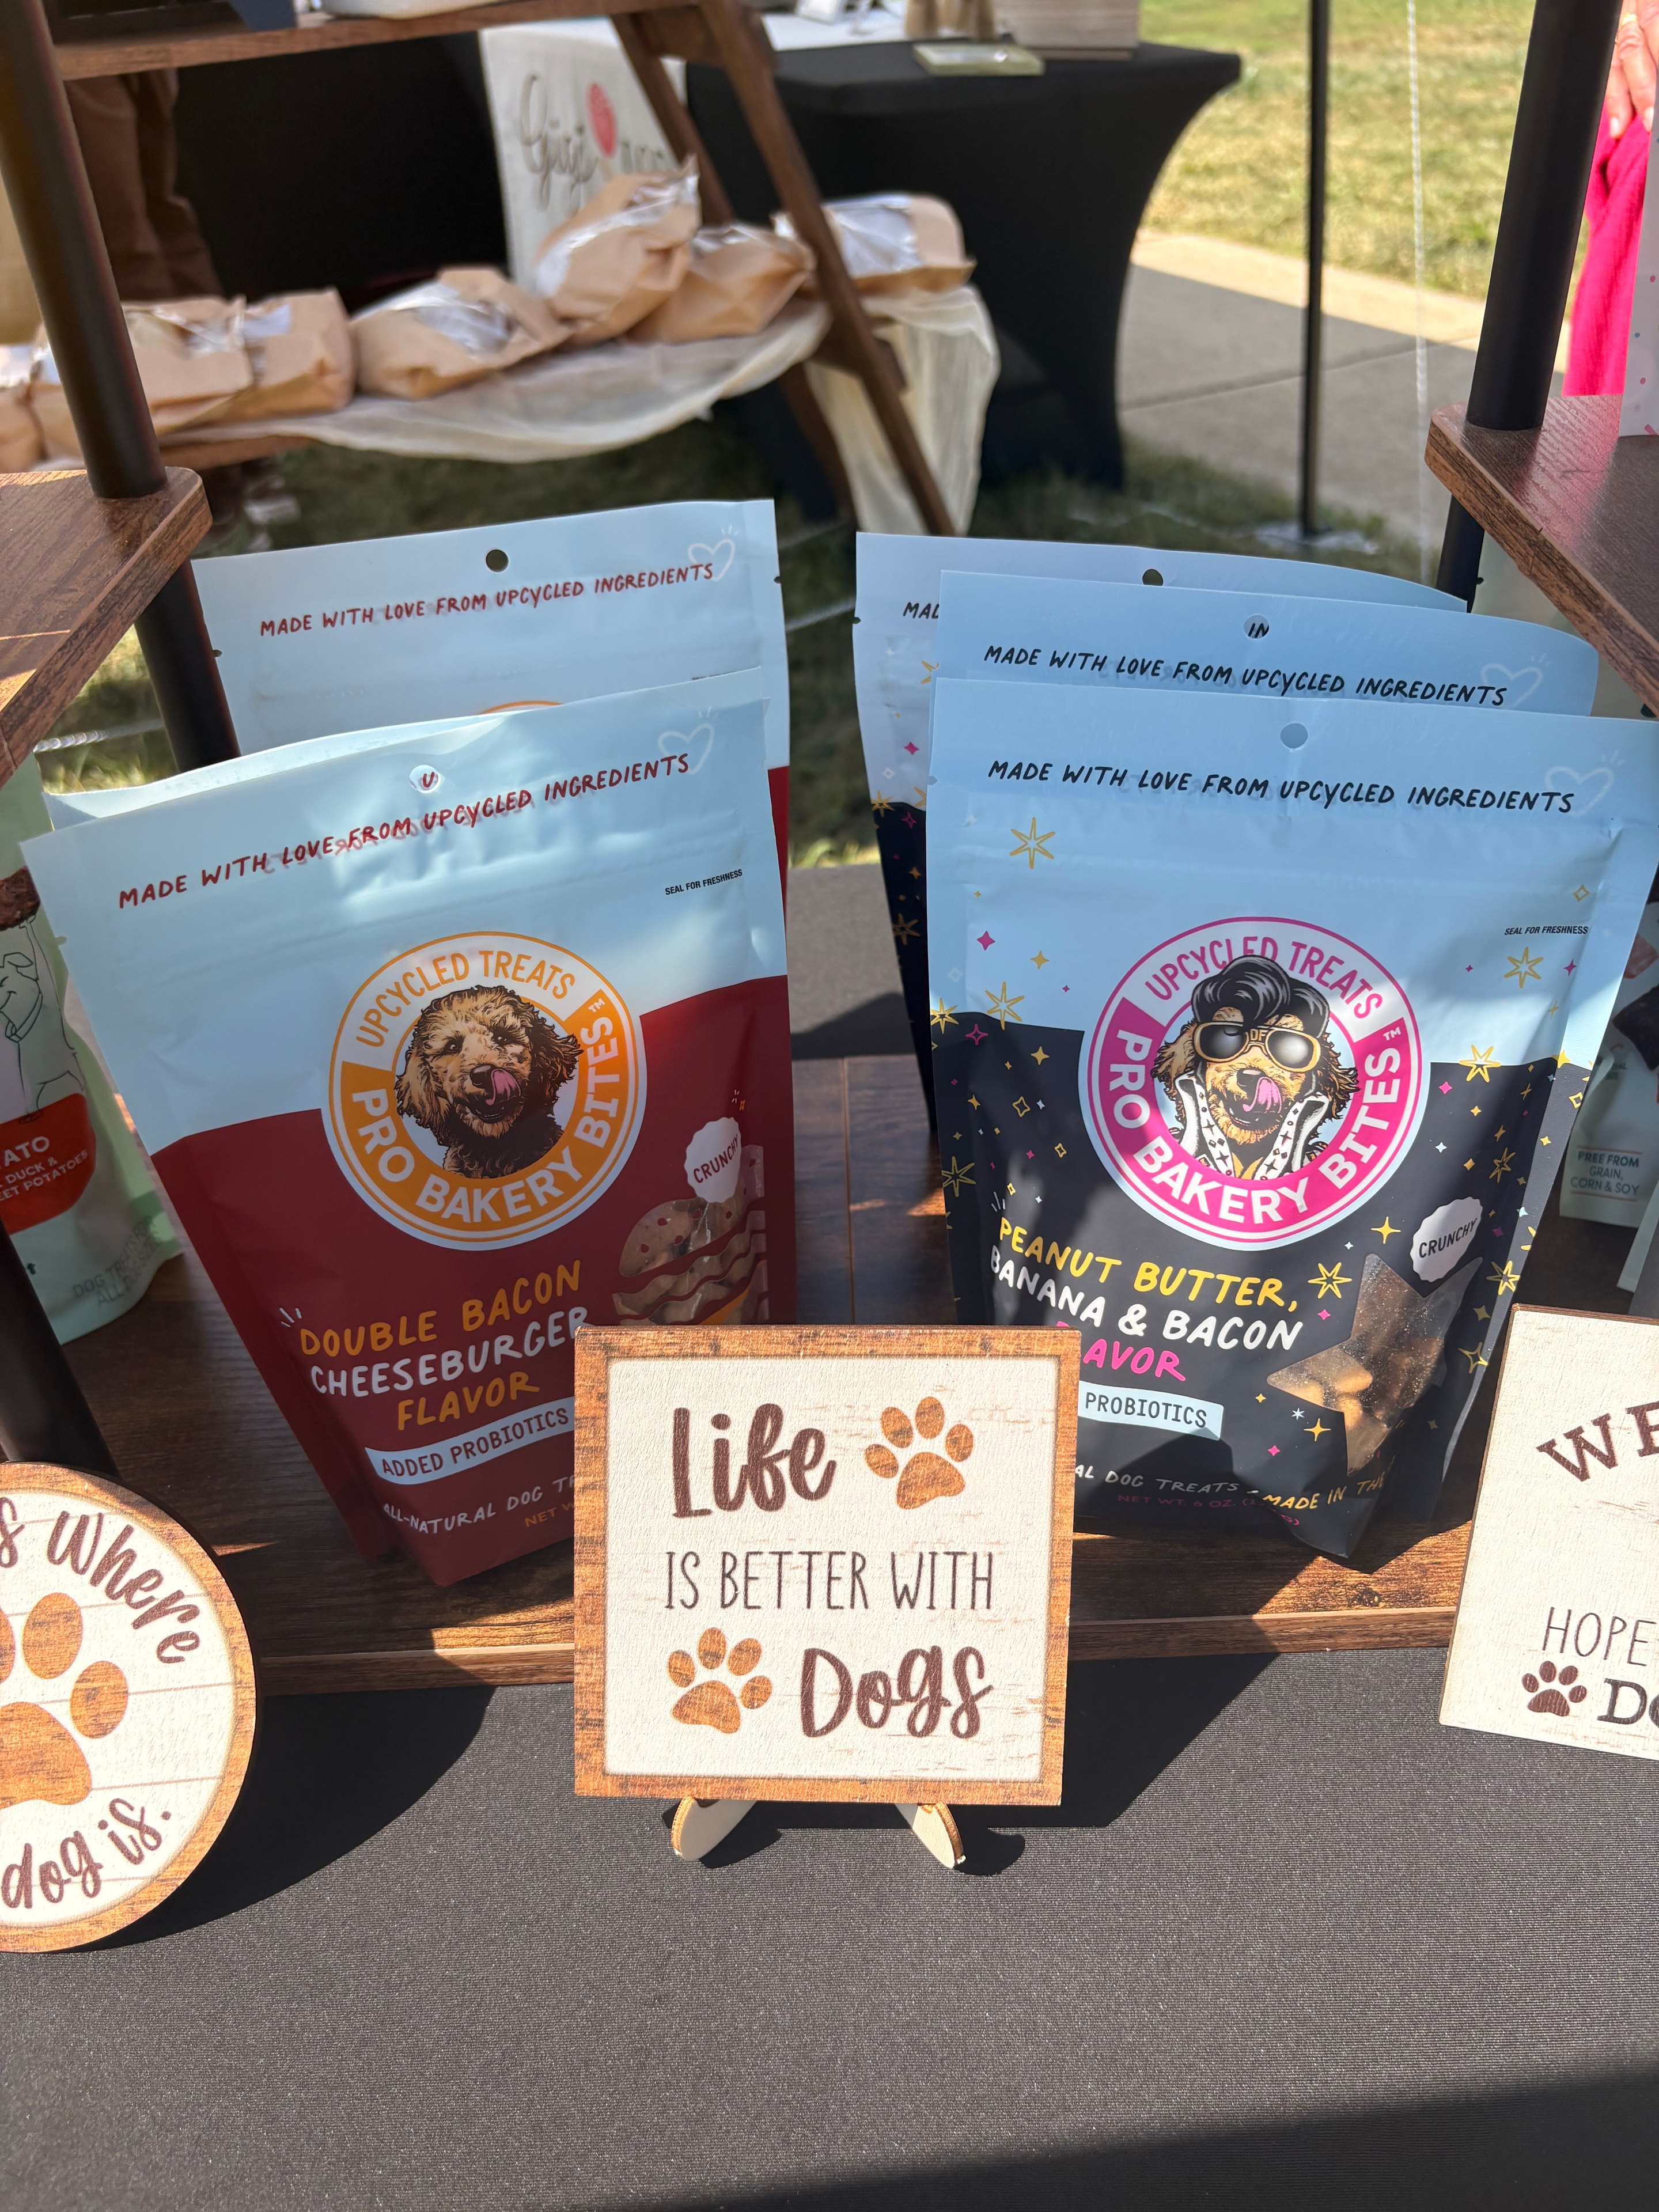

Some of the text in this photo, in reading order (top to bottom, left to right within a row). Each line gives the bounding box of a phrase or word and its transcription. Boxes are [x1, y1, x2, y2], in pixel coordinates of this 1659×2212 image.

[261, 563, 713, 637] MADE WITH LOVE FROM UPCYCLED INGREDIENTS
[902, 601, 940, 619] MAD
[984, 645, 1507, 706] MADE WITH LOVE FROM UPCYCLED INGREDIENTS
[988, 760, 1574, 813] MADE WITH LOVE FROM UPCYCLED INGREDIENTS
[119, 753, 689, 909] MADE WITH LOVE FROM UPCYCLED INGREDIENTS
[665, 869, 743, 896] SEAL FOR FRESHNESS
[1504, 926, 1589, 935] SEAL FOR FRESHNESS
[356, 950, 575, 1047] UPCYCLED TREATS
[1289, 941, 1382, 1019] TREATS
[0, 1136, 50, 1168] ATO
[353, 1089, 415, 1183] PRO
[415, 1149, 582, 1224] BAKERY
[1108, 1029, 1153, 1129] PRO
[1133, 1135, 1309, 1225] BAKERY
[5, 1157, 58, 1184] DUCK &
[23, 1149, 88, 1191] POTATOES
[693, 1134, 740, 1184] CRUNCHY
[1570, 1176, 1640, 1196] CORN & SOY
[1577, 1150, 1640, 1168] FREE FROM
[999, 1217, 1298, 1312] PEANUT BUTTER,
[1419, 1217, 1478, 1258] CRUNCHY
[301, 1260, 581, 1357] DOUBLE BACON
[991, 1244, 1303, 1350] BANANA & BACON
[311, 1306, 593, 1397] CHEESEBURGER
[1082, 1338, 1186, 1382] AVOR
[398, 1372, 540, 1431] FLAVOR
[1085, 1392, 1207, 1429] PROBIOTICS
[382, 1407, 570, 1477] ADDED PROBIOTICS
[672, 1403, 837, 1518] Life
[384, 1486, 543, 1534] ALL-NATURAL DOG
[524, 1509, 556, 1528] NET
[1105, 1470, 1144, 1487] DOG
[1156, 1478, 1240, 1493] TREATS
[1263, 1493, 1320, 1509] MADE
[1327, 1486, 1347, 1505] IN
[1117, 1495, 1151, 1503] NET
[665, 1551, 994, 1611] IS BETTER WITH
[1542, 1606, 1657, 1666] HOPE
[800, 1645, 995, 1740] Dogs
[1, 1797, 172, 1909] dog is.
